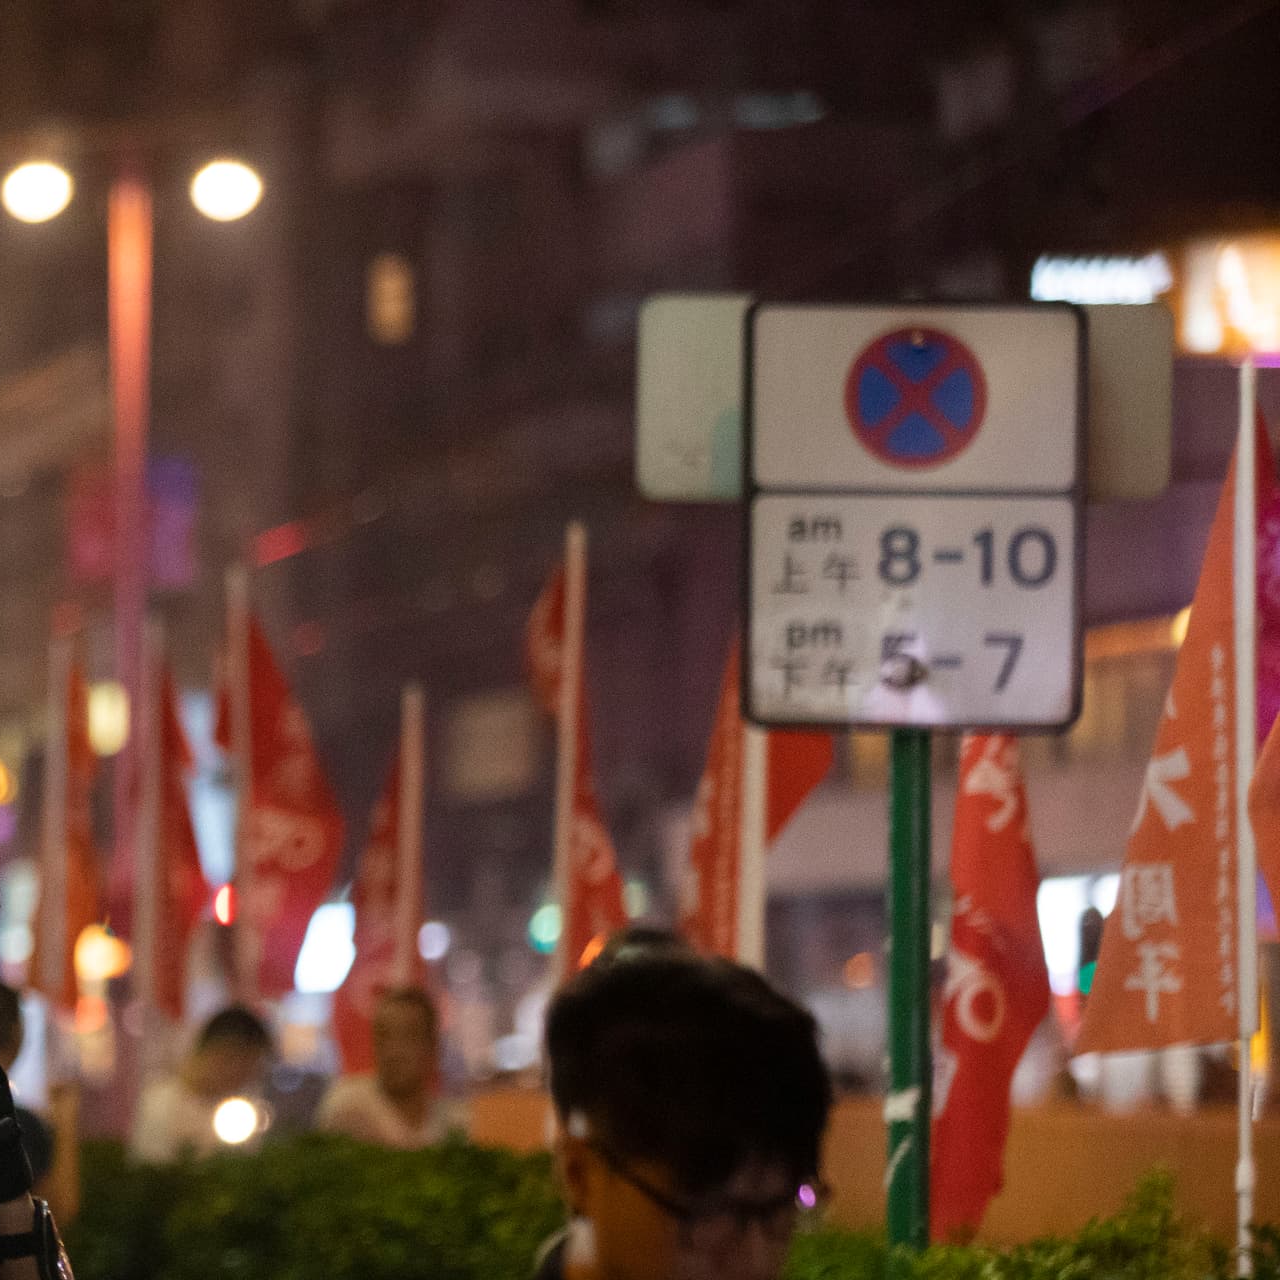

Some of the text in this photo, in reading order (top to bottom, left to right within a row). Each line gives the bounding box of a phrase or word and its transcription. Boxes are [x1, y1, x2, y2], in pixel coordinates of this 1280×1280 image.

[789, 517, 842, 541] am
[878, 525, 1058, 588] 8-10
[787, 624, 842, 650] pm
